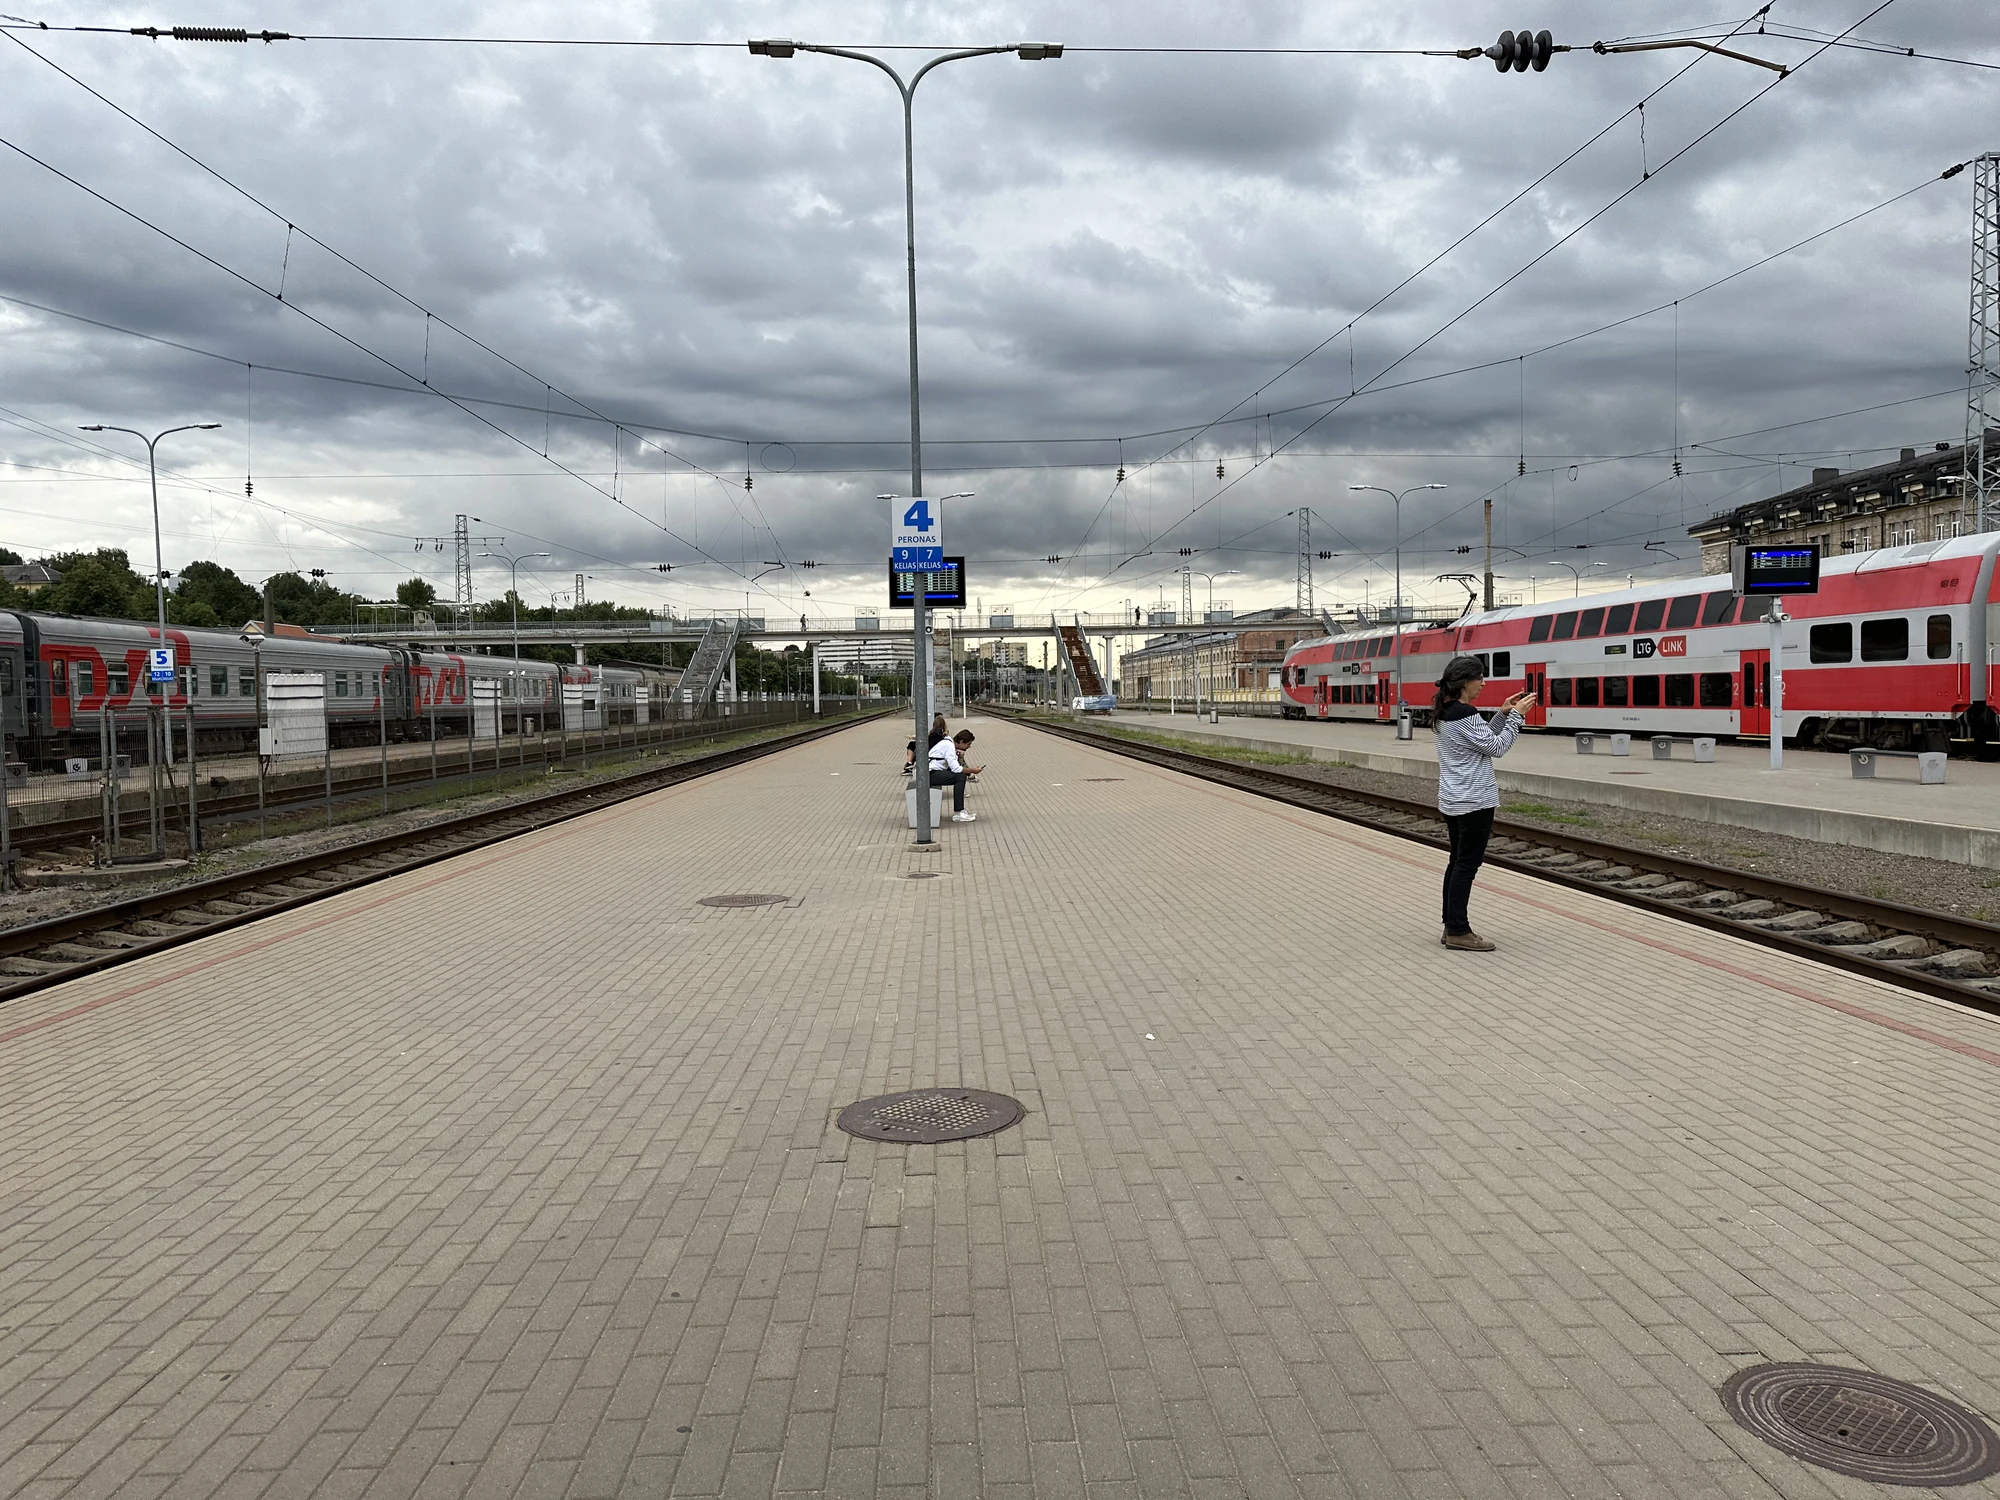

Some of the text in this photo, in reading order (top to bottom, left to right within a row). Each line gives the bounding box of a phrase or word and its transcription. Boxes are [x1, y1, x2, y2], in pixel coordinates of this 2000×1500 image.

[904, 500, 934, 532] 4
[902, 550, 908, 560] 9
[926, 550, 933, 559] 7
[1637, 640, 1683, 654] LTG LINK
[156, 651, 168, 665] 5
[1733, 682, 1739, 695] 2
